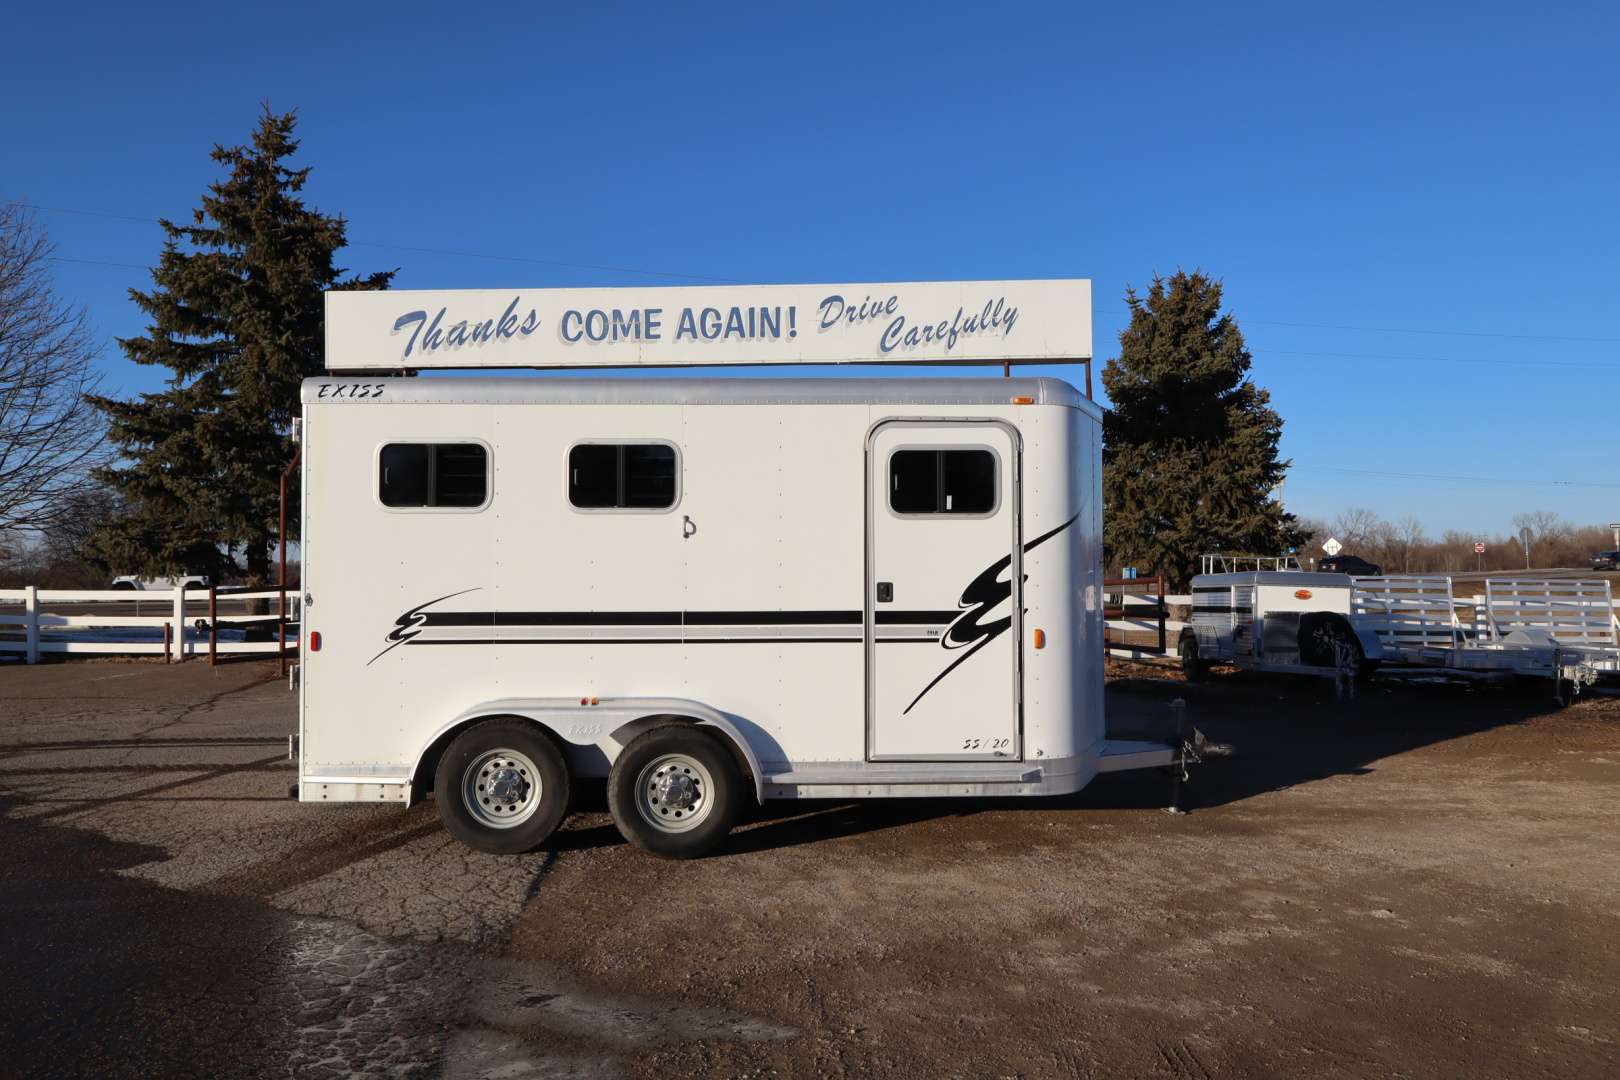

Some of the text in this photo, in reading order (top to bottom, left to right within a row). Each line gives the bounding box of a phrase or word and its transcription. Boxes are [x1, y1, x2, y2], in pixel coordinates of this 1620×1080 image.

[394, 296, 541, 357] Thanks
[561, 306, 798, 342] COME AGAIN!
[819, 295, 899, 328] Drive
[880, 297, 1019, 352] Carefully
[317, 384, 386, 398] EXISS
